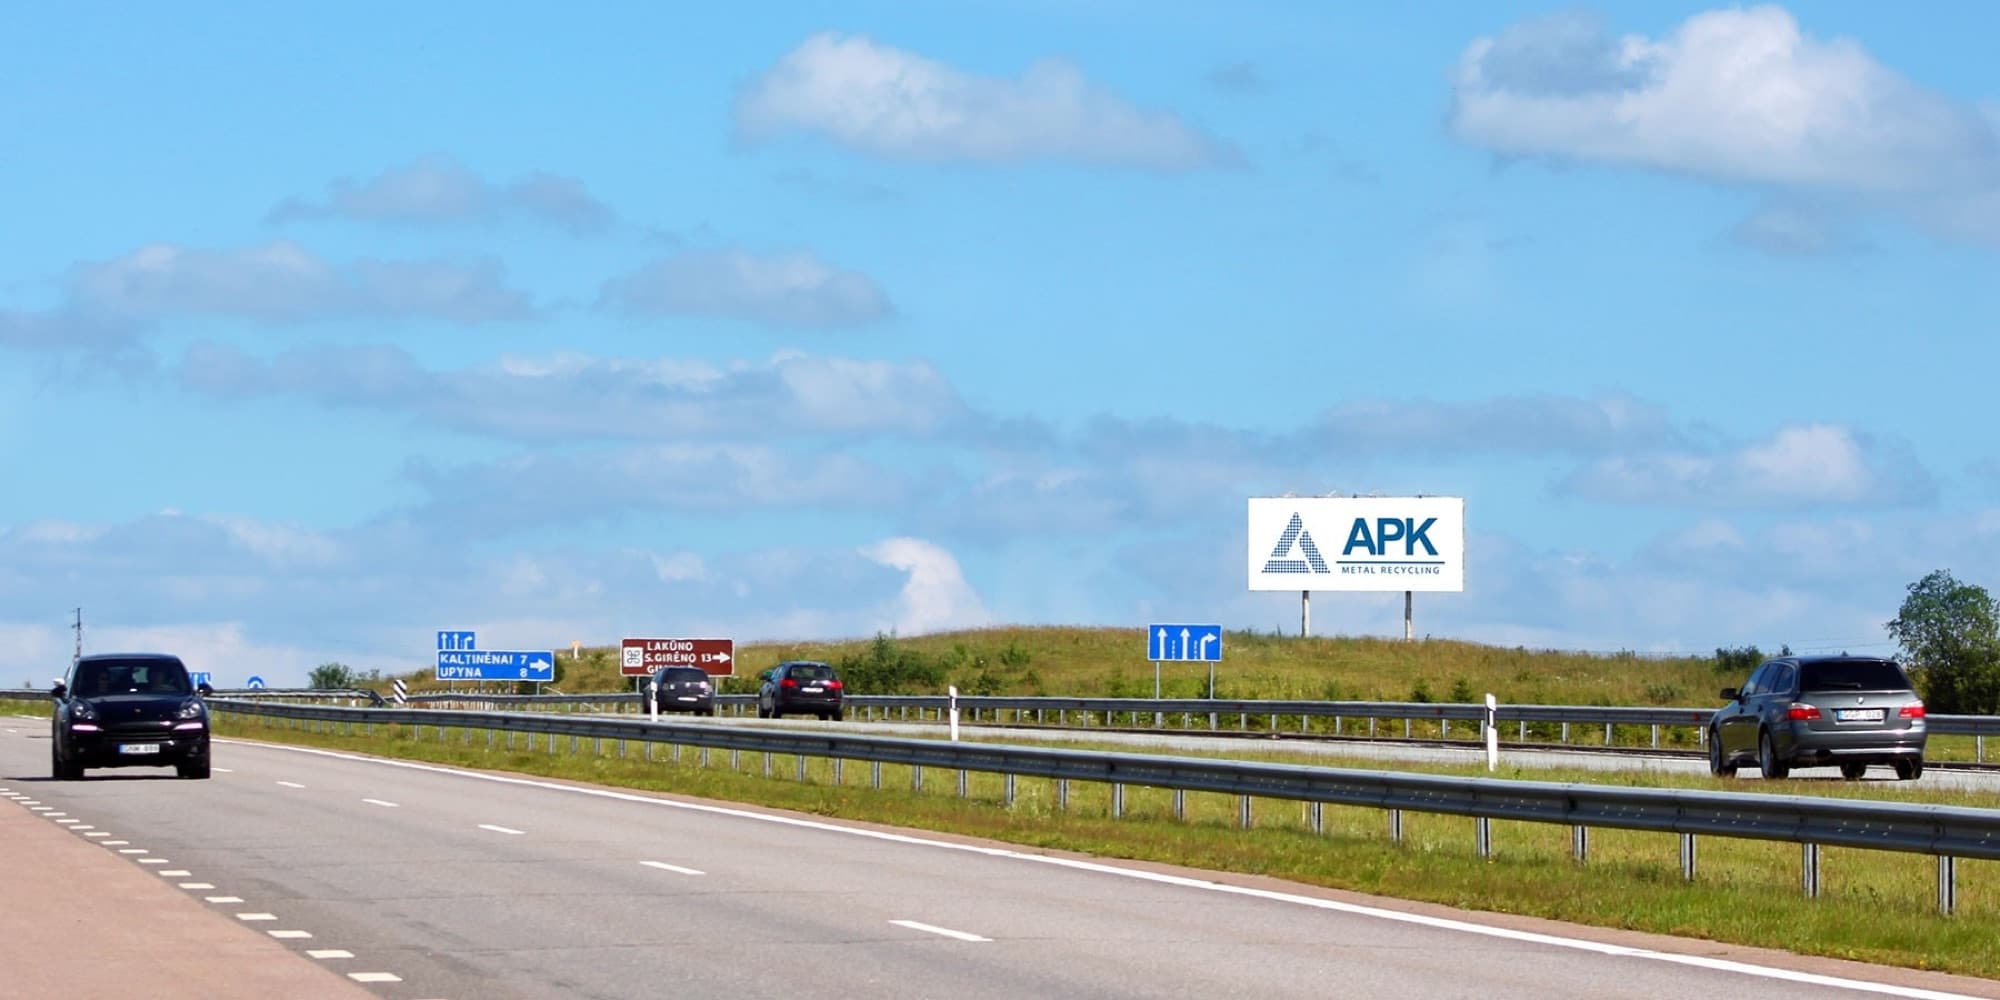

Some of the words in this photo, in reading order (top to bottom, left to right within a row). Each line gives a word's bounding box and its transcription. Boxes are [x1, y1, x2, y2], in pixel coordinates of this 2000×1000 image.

[1342, 517, 1439, 555] APK
[1341, 566, 1376, 574] METAL
[1381, 566, 1440, 575] RECYCLING
[440, 652, 513, 665] KALTINĖNAI
[520, 655, 528, 665] 7
[701, 653, 712, 662] 13
[440, 667, 482, 677] UPYNA
[520, 668, 528, 678] 8
